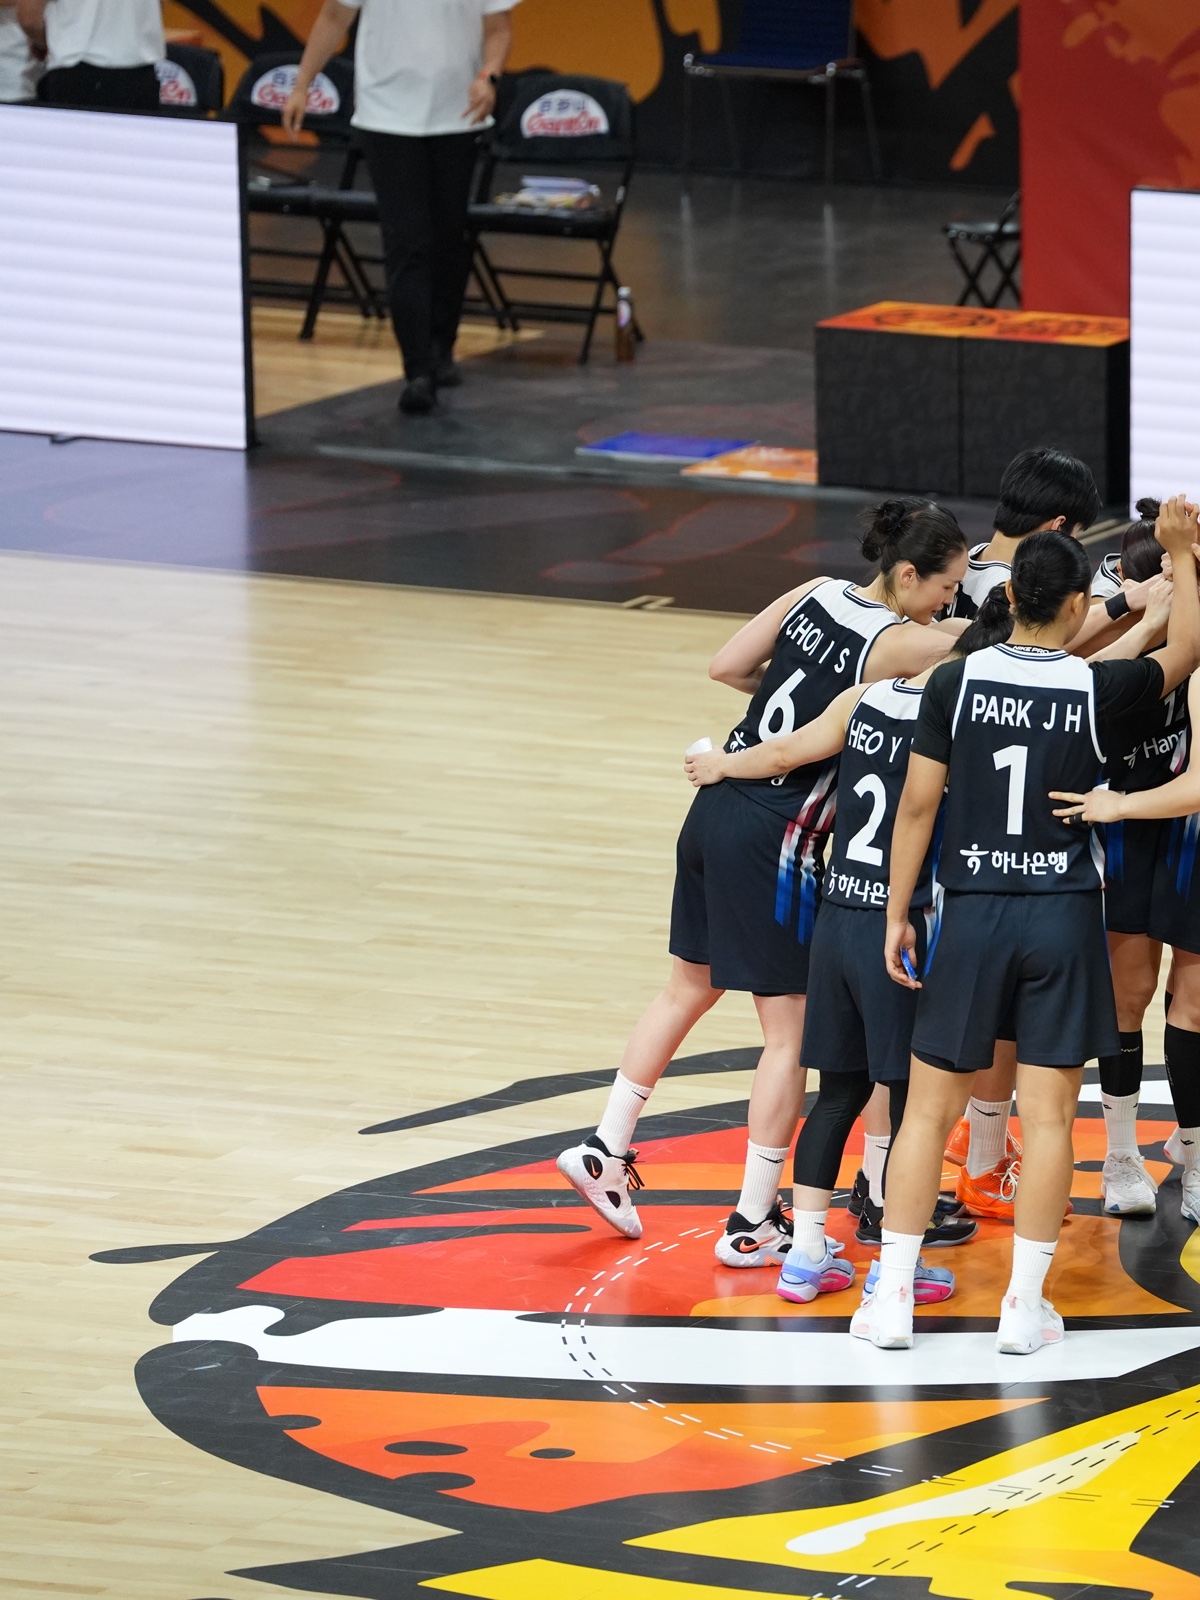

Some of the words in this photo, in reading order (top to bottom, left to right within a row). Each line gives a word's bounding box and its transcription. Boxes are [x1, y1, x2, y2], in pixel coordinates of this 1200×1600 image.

[785, 613, 825, 656] CHOI
[818, 640, 835, 664] I
[834, 647, 850, 674] S
[757, 667, 807, 743] 6
[971, 693, 1034, 729] PARK
[1042, 702, 1057, 730] J
[1064, 703, 1082, 733] H
[848, 718, 884, 755] HEO
[888, 736, 902, 763] Y
[992, 744, 1028, 835] 1
[846, 773, 887, 867] 2
[837, 873, 890, 906] 하나은
[991, 850, 1068, 876] 하나은행
